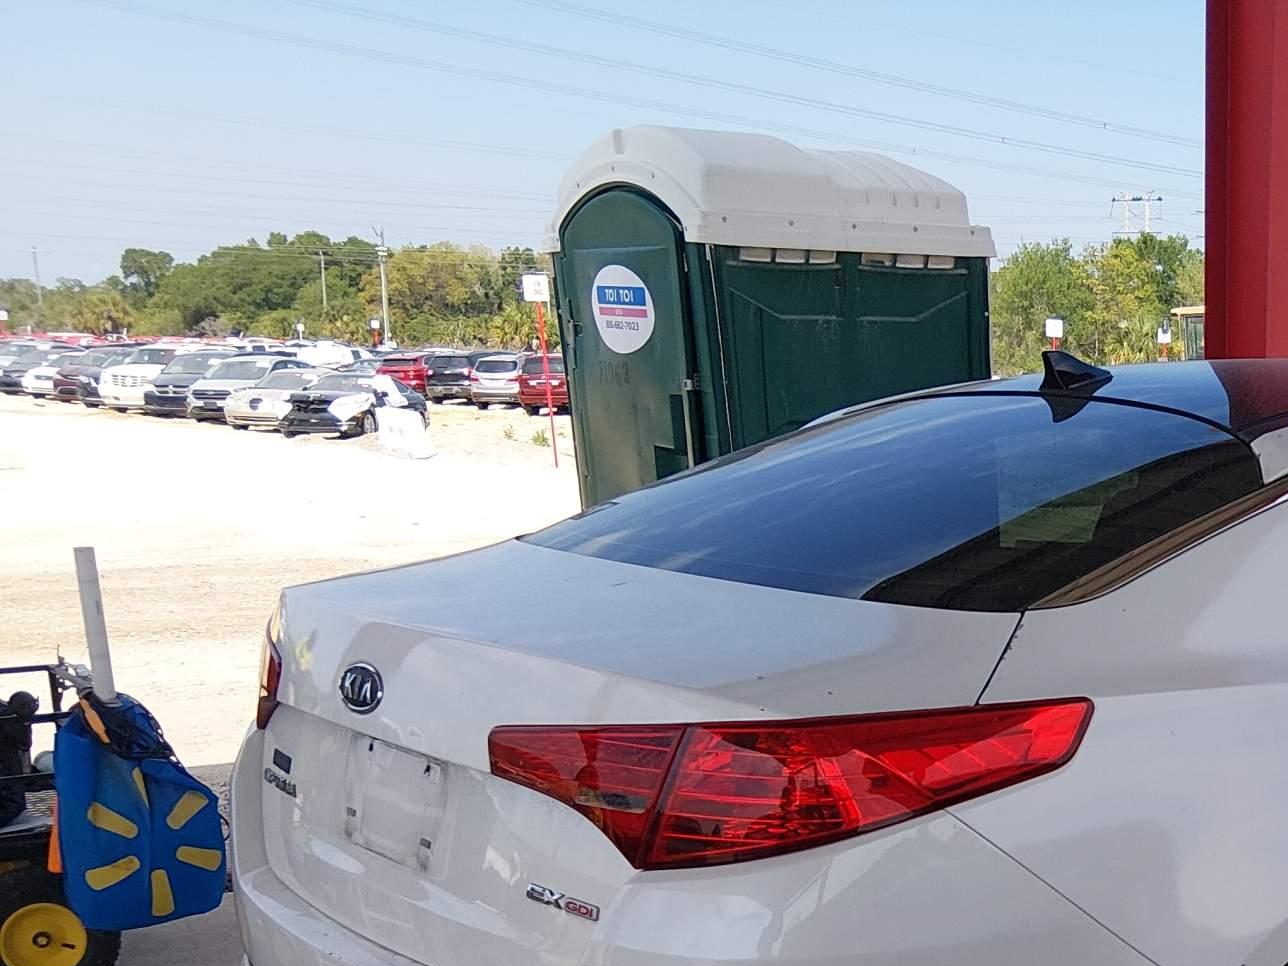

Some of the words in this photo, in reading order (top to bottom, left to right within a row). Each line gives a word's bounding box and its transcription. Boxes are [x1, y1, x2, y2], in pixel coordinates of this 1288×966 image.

[605, 288, 617, 302] TOI
[619, 289, 634, 303] TOI
[344, 672, 372, 704] KIA
[526, 882, 565, 911] EX
[565, 901, 594, 918] GDI
